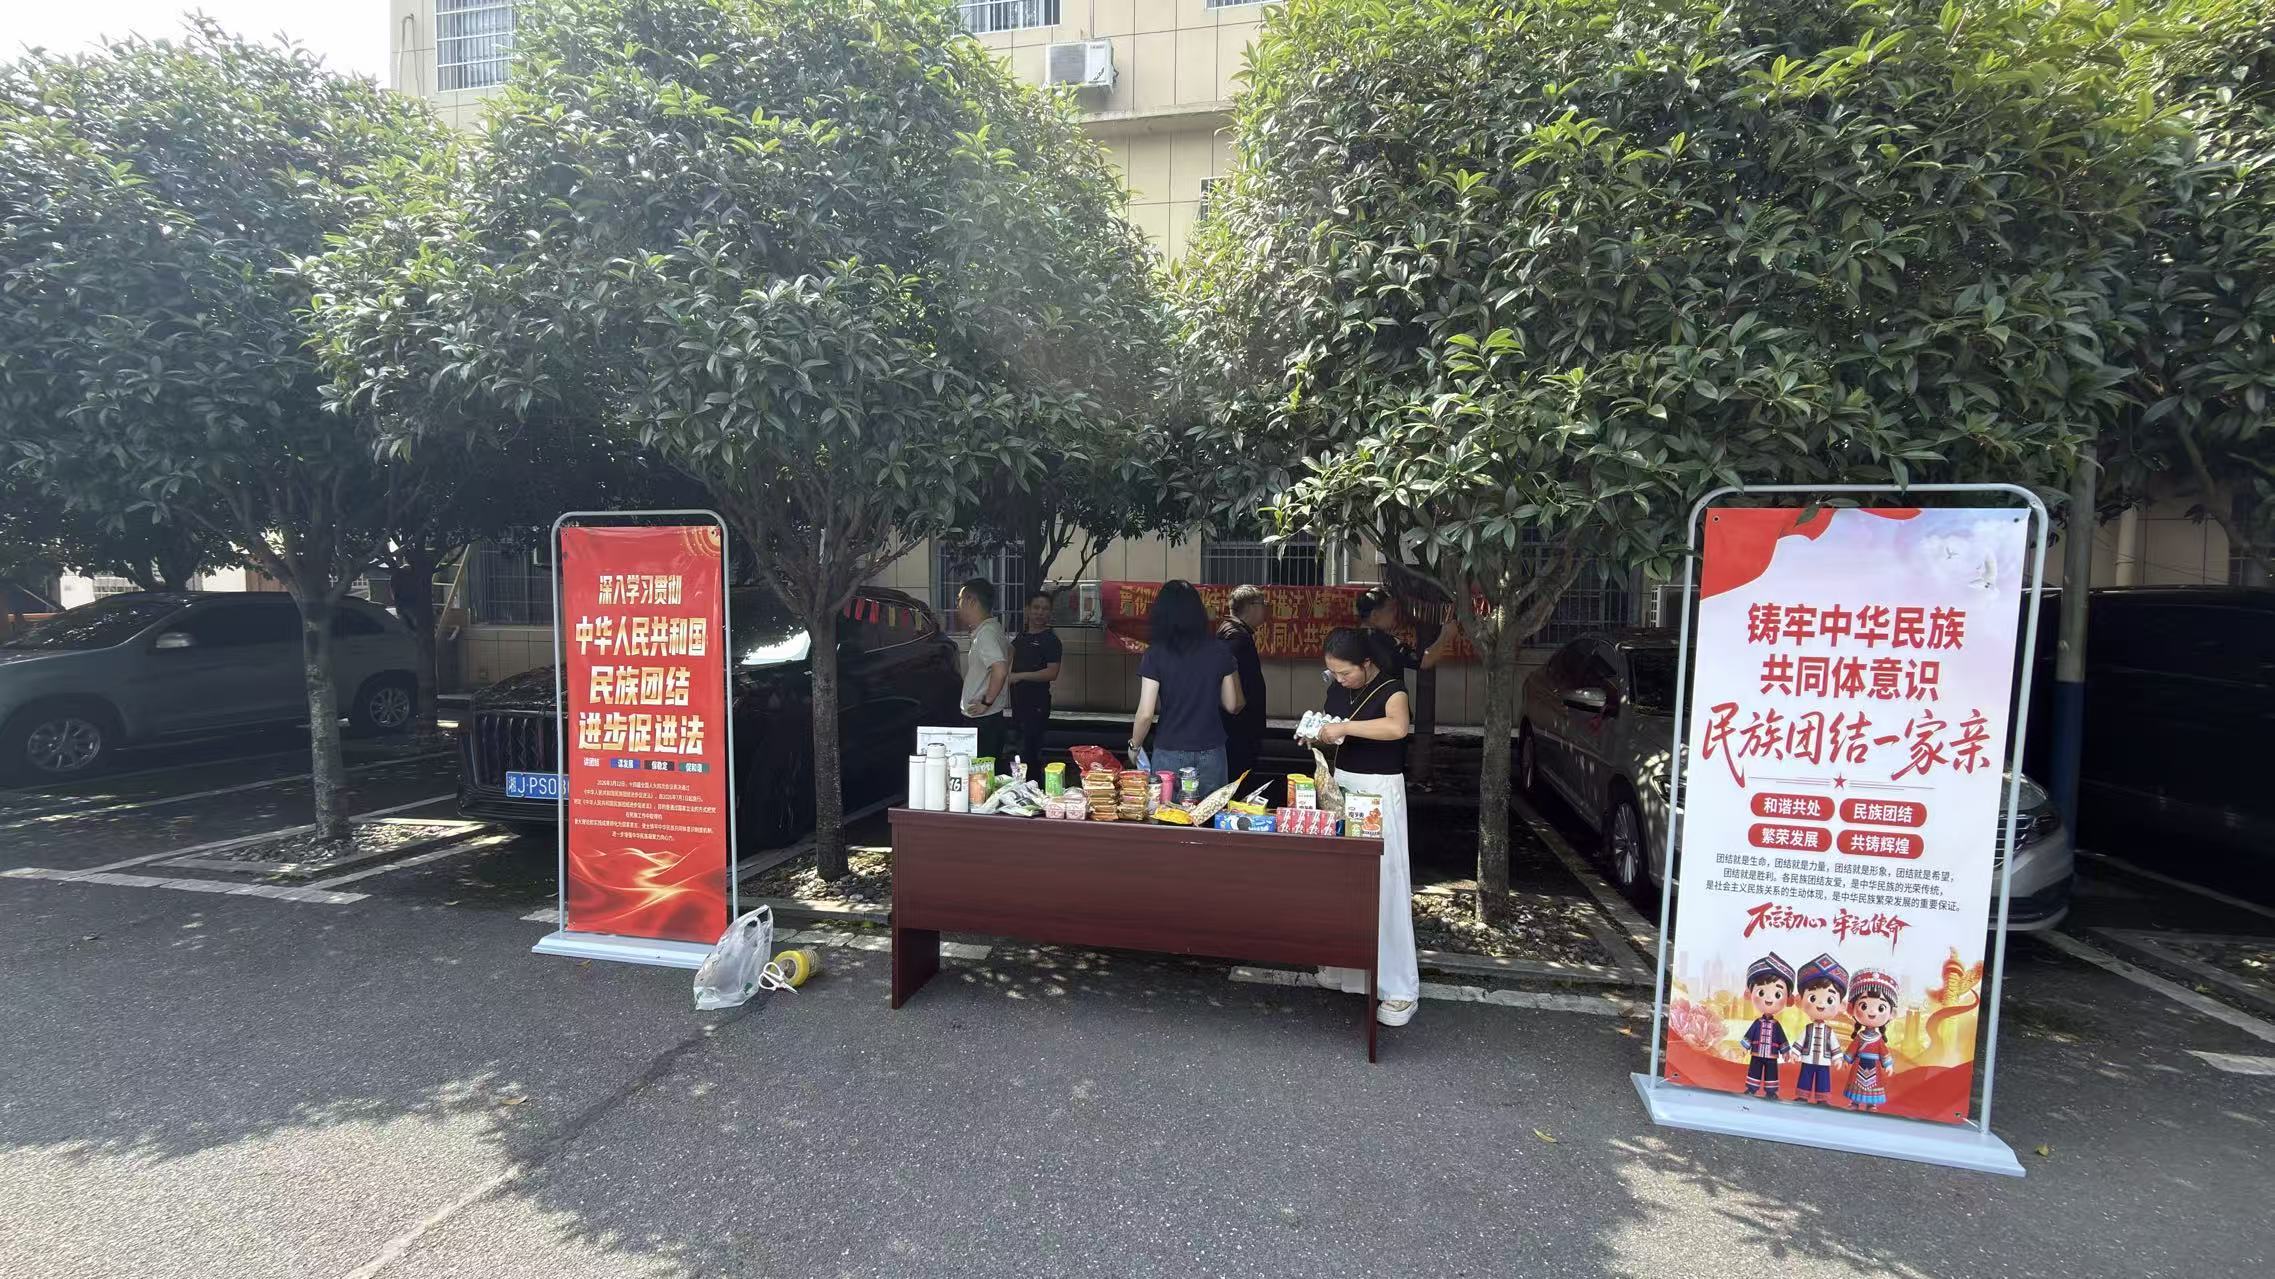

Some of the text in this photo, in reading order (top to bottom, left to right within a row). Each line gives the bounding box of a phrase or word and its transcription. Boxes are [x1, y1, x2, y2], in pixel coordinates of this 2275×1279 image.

[599, 575, 682, 604] 深入学习贯彻
[575, 616, 707, 656] 中华人民共和国
[1747, 602, 1966, 650] 铸牢中华民族
[590, 665, 691, 706] 民族团结
[1760, 653, 1940, 702] 共同体意识
[578, 712, 705, 755] 进步促进法
[1702, 702, 1992, 788] 民族团结一家亲
[1764, 797, 1913, 823] 和谐共处 民族团结
[1761, 828, 1910, 855] 繁荣发展 共铸辉煌
[1716, 853, 1954, 883] 团结就是生命，团结就是力量，团结就是形象，团结就是希望，
[1723, 868, 1943, 896] 团结就是胜利。各民族团结友爱，是中华民族的光荣传统，
[1706, 880, 1960, 912] 是社会主义民族关系的生动体现，是中华民族繁荣发展的重要保证。
[1743, 901, 1827, 938] 不忘初心
